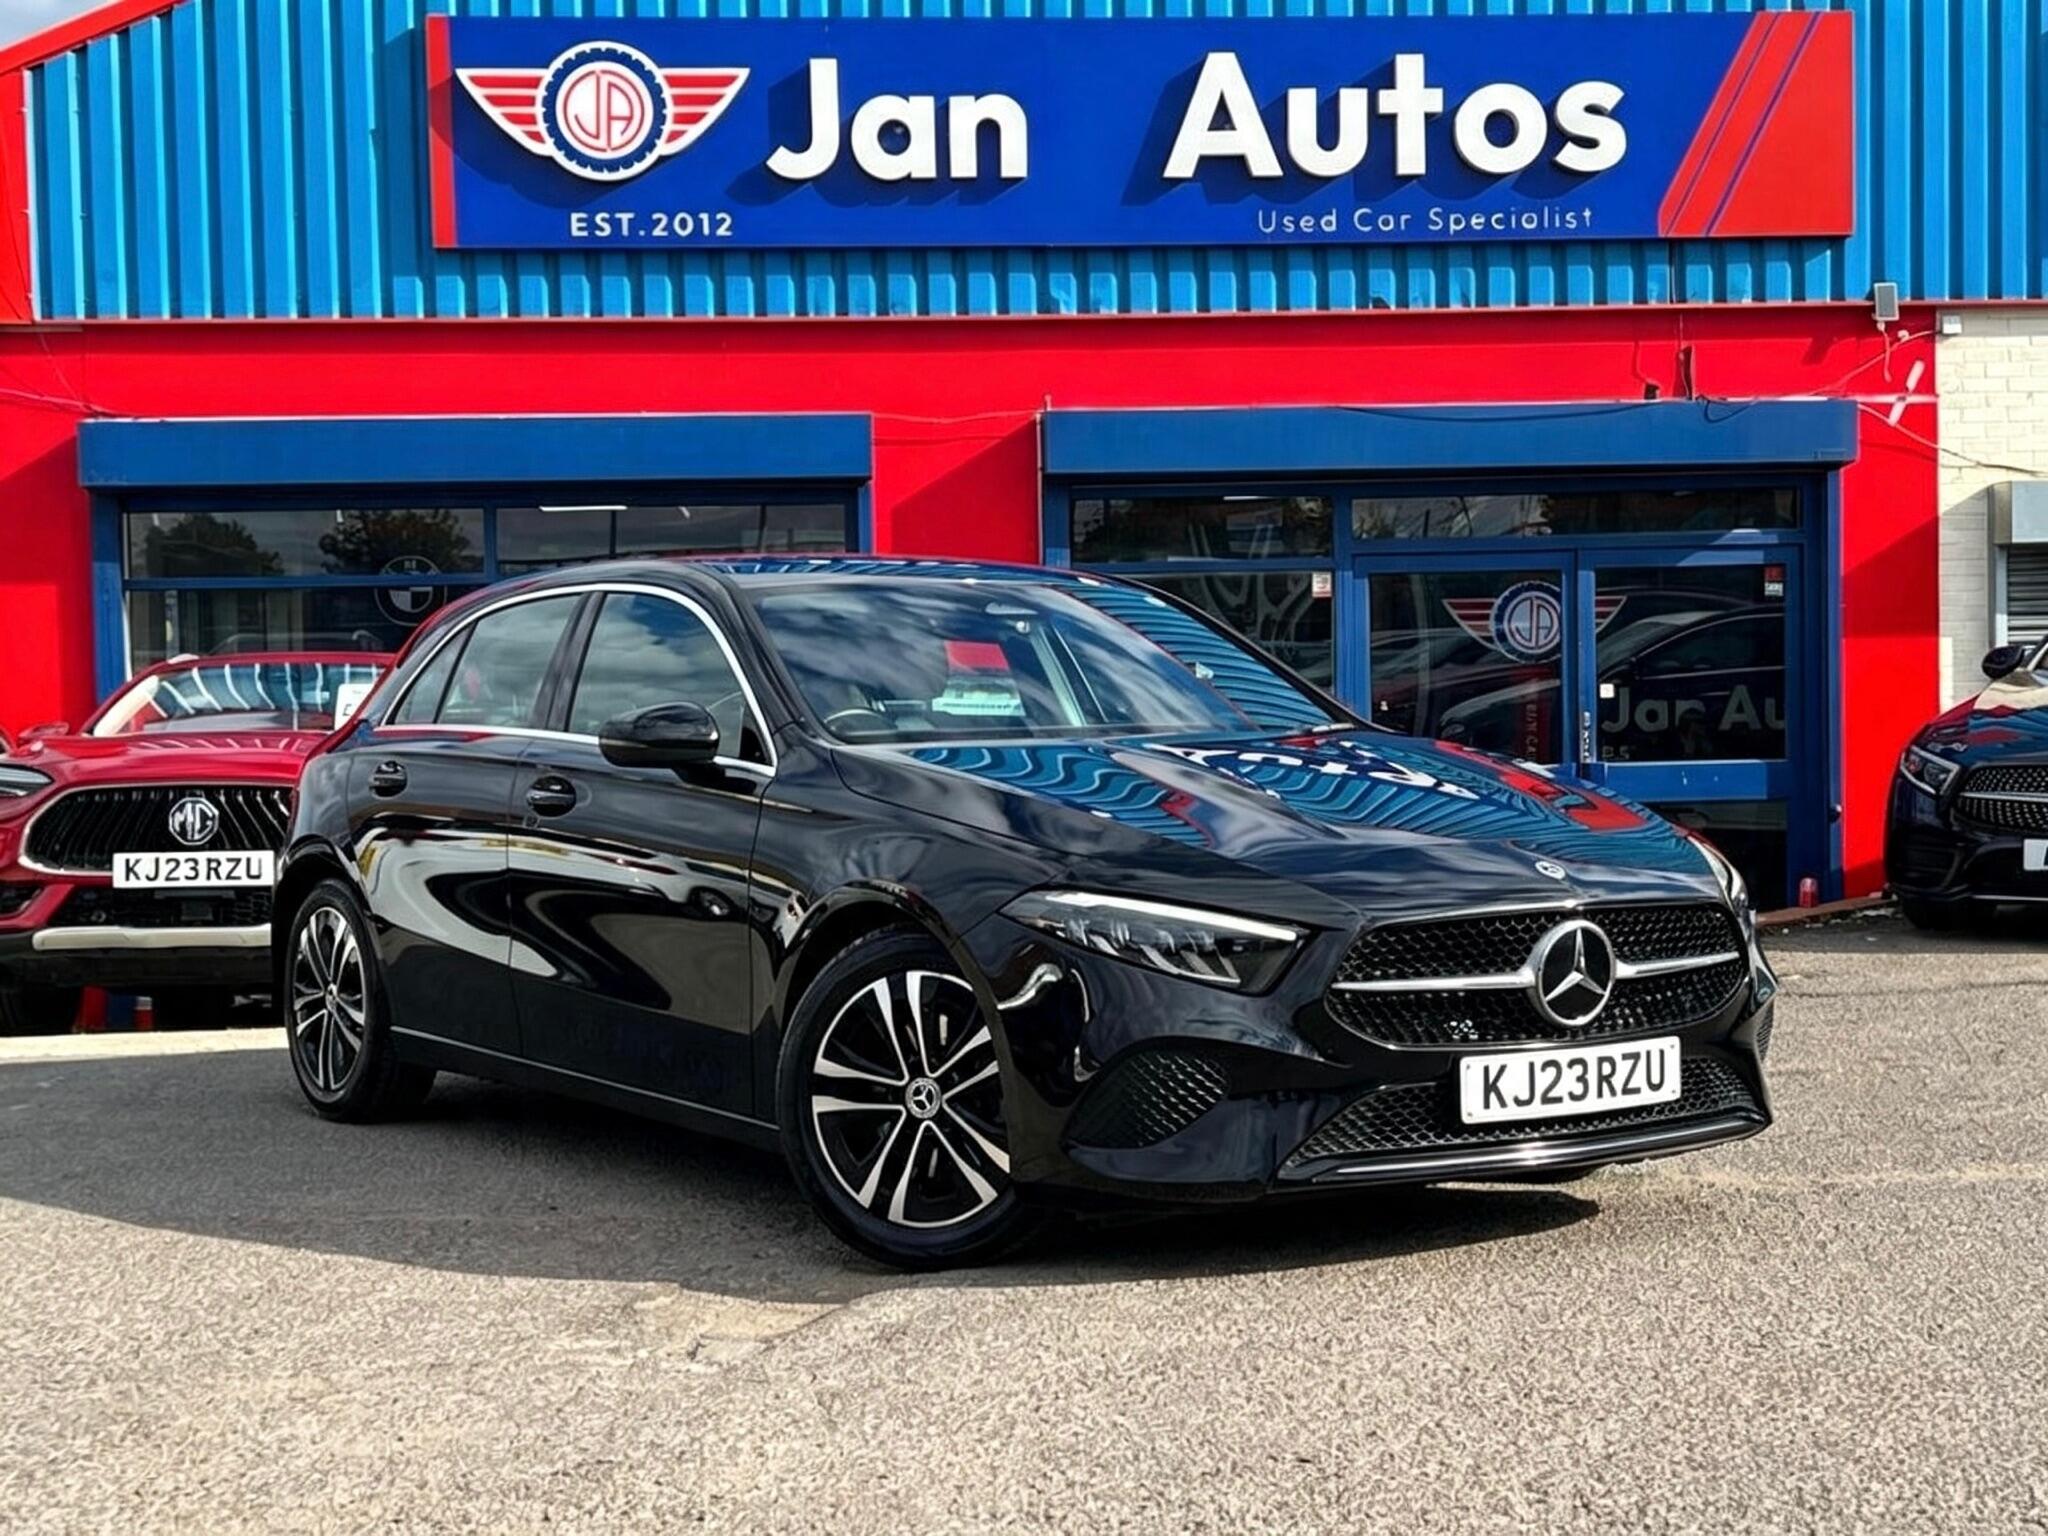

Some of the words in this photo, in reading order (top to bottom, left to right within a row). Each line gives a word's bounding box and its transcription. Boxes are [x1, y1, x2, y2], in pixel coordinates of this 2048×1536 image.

[766, 58, 1028, 180] Jan
[1163, 51, 1627, 178] Autos
[570, 211, 733, 237] EST.2012
[1258, 208, 1338, 233] Used
[1353, 207, 1412, 232] Car
[1428, 206, 1592, 235] Specialist
[174, 802, 213, 840] MG
